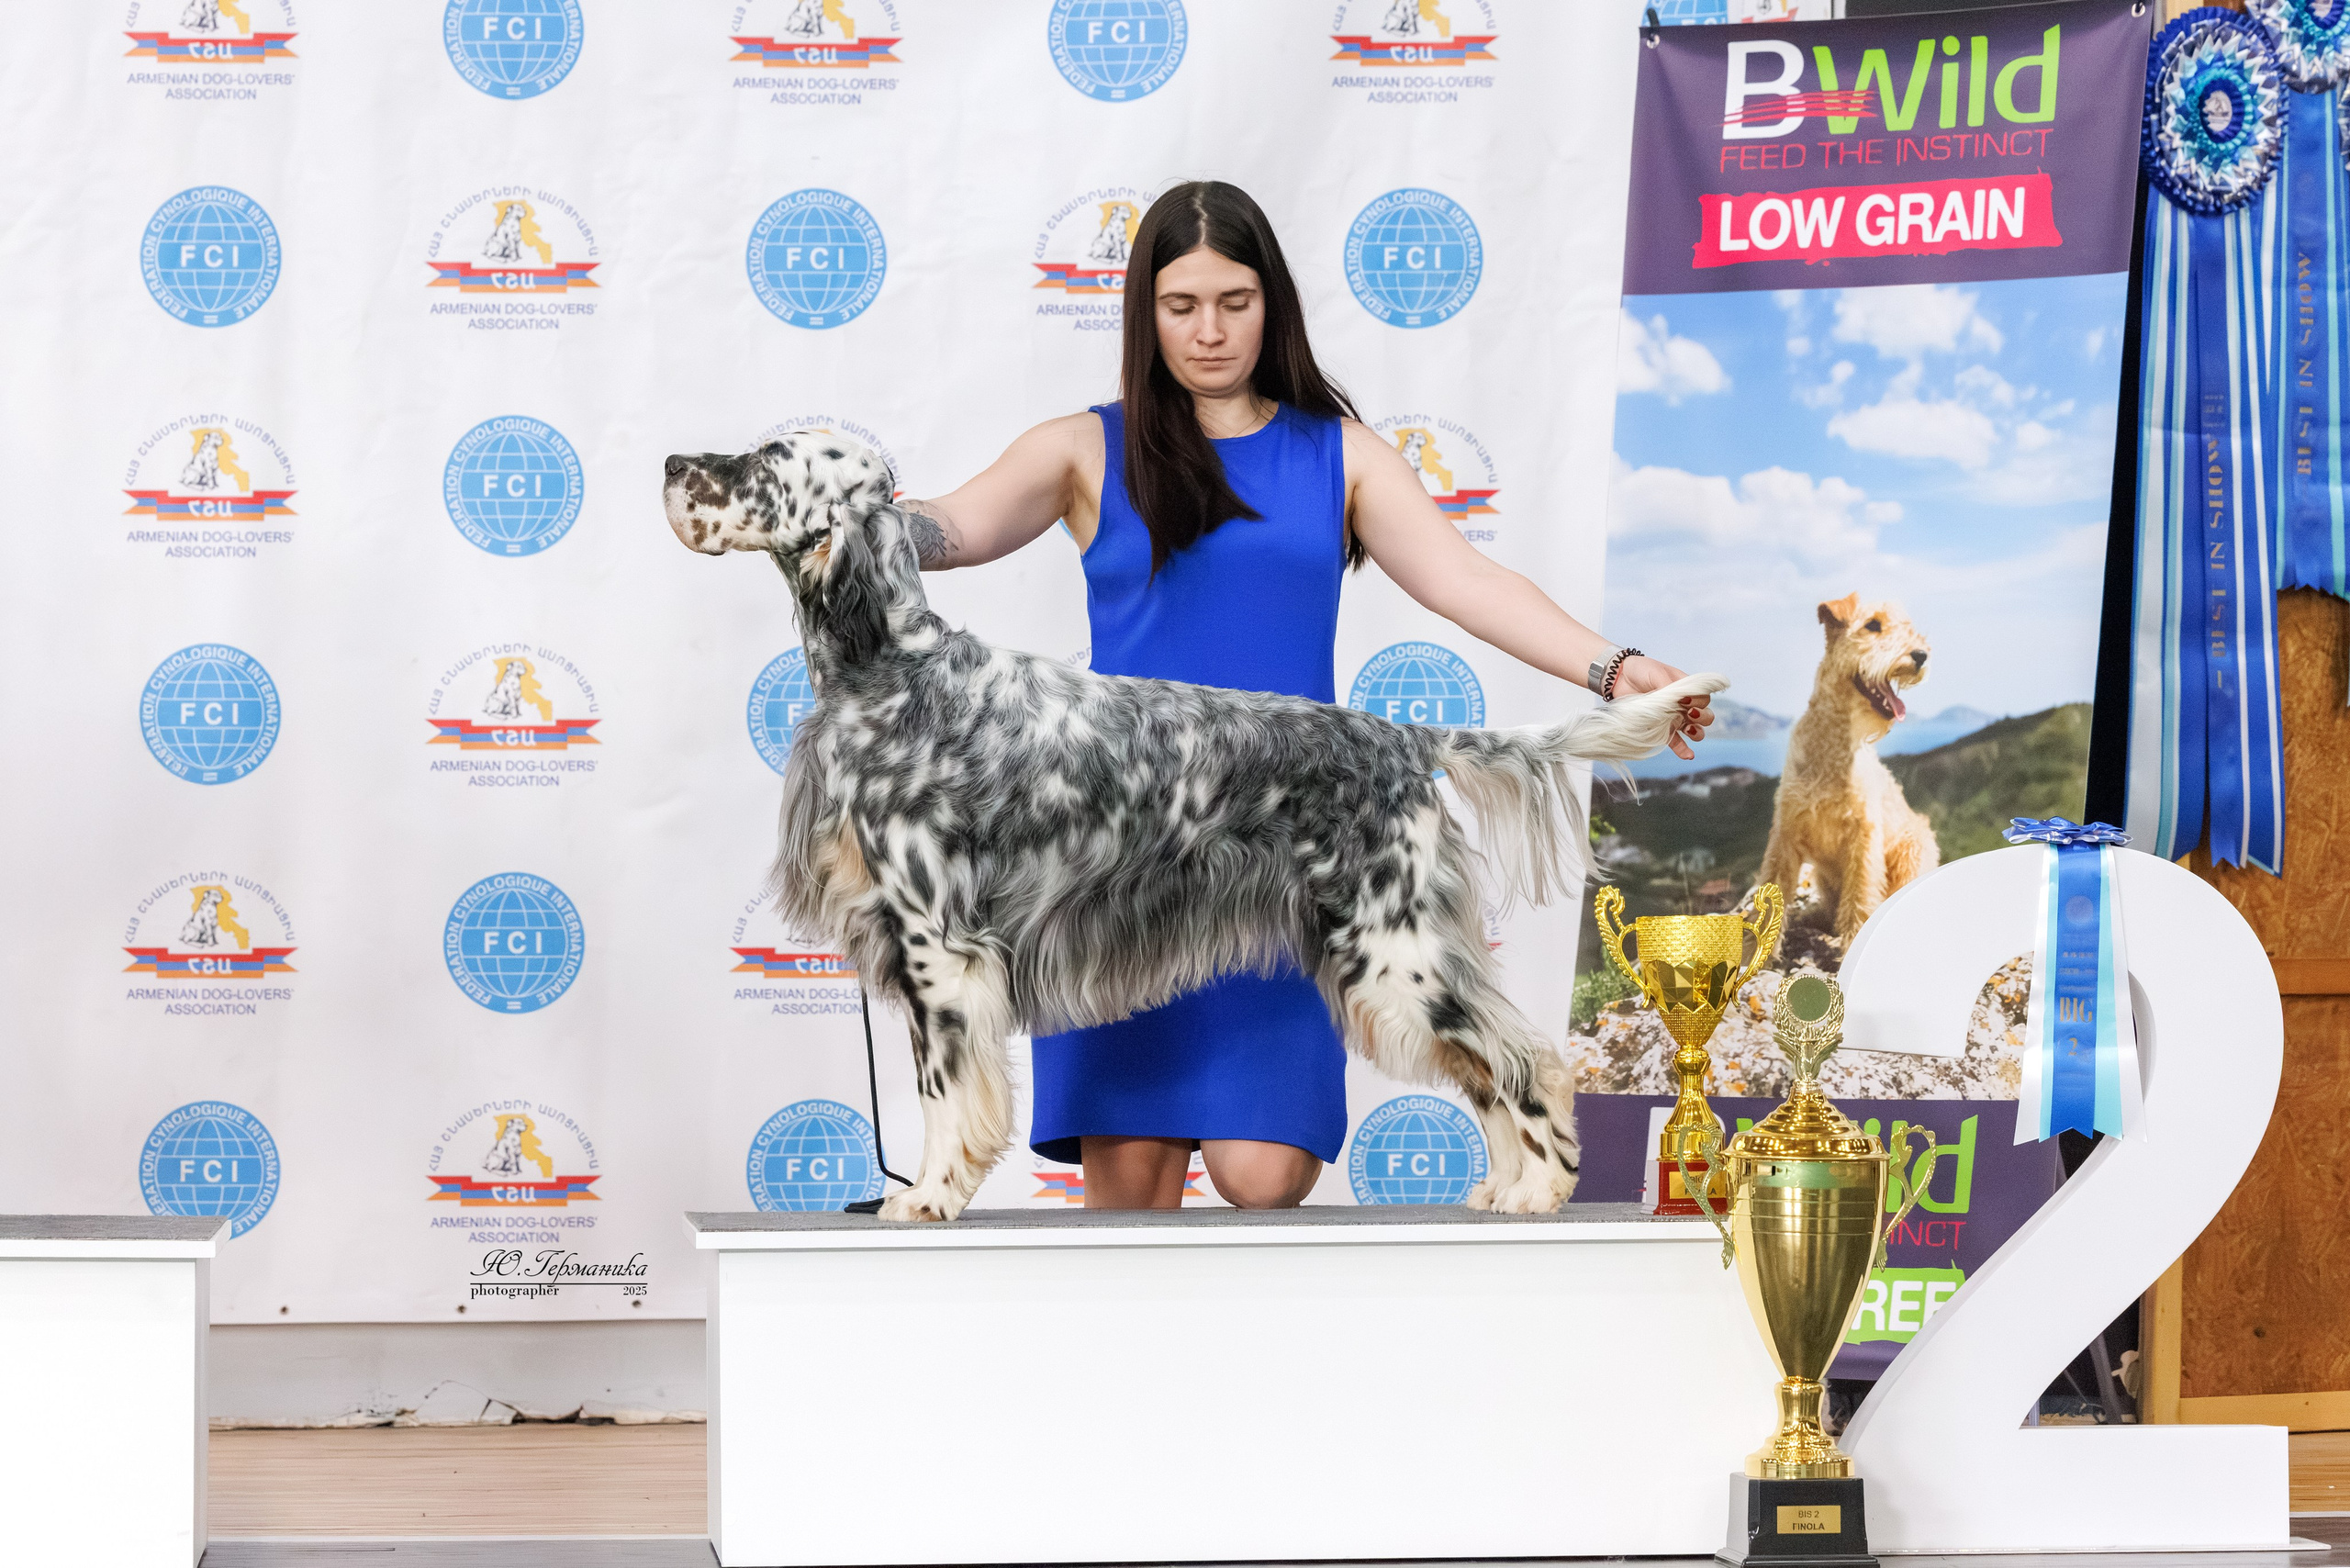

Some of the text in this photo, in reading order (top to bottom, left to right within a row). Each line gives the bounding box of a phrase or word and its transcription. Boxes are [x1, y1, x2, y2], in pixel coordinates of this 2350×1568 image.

[483, 17, 542, 40] FCI
[1088, 19, 1146, 43] FCI
[446, 0, 581, 92] FEDERATION ERNATIONALE
[1051, 0, 1184, 95] FEDERATION ERNATIONALE
[127, 73, 198, 84] ARMENIAN
[733, 78, 803, 90] ARMENIAN
[1330, 76, 1400, 88] ARMENIAN
[1721, 23, 2060, 140] BWild
[164, 88, 257, 100] ASSOCIATION
[770, 94, 862, 104] ASSOCIATION
[1367, 92, 1458, 103] ASSOCIATION
[1719, 129, 2054, 174] FEED THE INSTINCT
[1719, 186, 2025, 252] LOW GRAIN
[143, 188, 278, 319] FEDERATION CYNOLOGIQUE INTERNATIONALE
[180, 244, 239, 268] FCI
[749, 191, 884, 321] FEDERATION CYNOLOGIQUE INTERNATIONALE
[786, 246, 845, 270] FCI
[1347, 190, 1480, 320] FEDERATION CYNOLOGIQUE INTERNATIONALE
[1383, 245, 1441, 269] FCI
[430, 303, 501, 315] ARMENIAN
[1035, 304, 1107, 316] ARMENIAN
[467, 319, 560, 330] ASSOCIATION
[446, 418, 581, 549] FEDERATION CYNOLOGIQUE INTERNATIONALE
[483, 474, 542, 498] FCI
[127, 531, 198, 543] ARMENIAN
[164, 546, 257, 557] ASSOCIATION
[1358, 644, 1452, 688] CYNOLOGIQUE
[151, 646, 249, 689] CYNOLOGIQUE
[233, 663, 278, 777] INTERNATIONALE
[180, 701, 239, 725] FCI
[1386, 700, 1444, 723] FCI
[430, 760, 501, 772] ARMENIAN
[467, 776, 560, 787] ASSOCIATION
[446, 875, 581, 1006] FEDERATION CYNOLOGIQUE INTERNATIONALE
[483, 931, 542, 955] FCI
[127, 988, 198, 1000] ARMENIAN
[734, 988, 861, 1000] ARMENIAN DOG-LO
[164, 1003, 257, 1014] ASSOCIATION
[2059, 997, 2093, 1023] BIG
[2067, 1037, 2078, 1056] 2
[758, 1103, 854, 1145] CYNOLOGIQUE
[1360, 1099, 1453, 1141] CYNOLOGIQUE
[150, 1103, 248, 1147] CYNOLOGIQUE
[232, 1120, 277, 1234] INTERNATIONALE
[179, 1159, 238, 1182] FCI
[787, 1159, 844, 1181] FCI
[1389, 1155, 1445, 1176] FCI
[431, 1216, 502, 1228] ARMENIAN
[468, 1232, 561, 1243] ASSOCIATION
